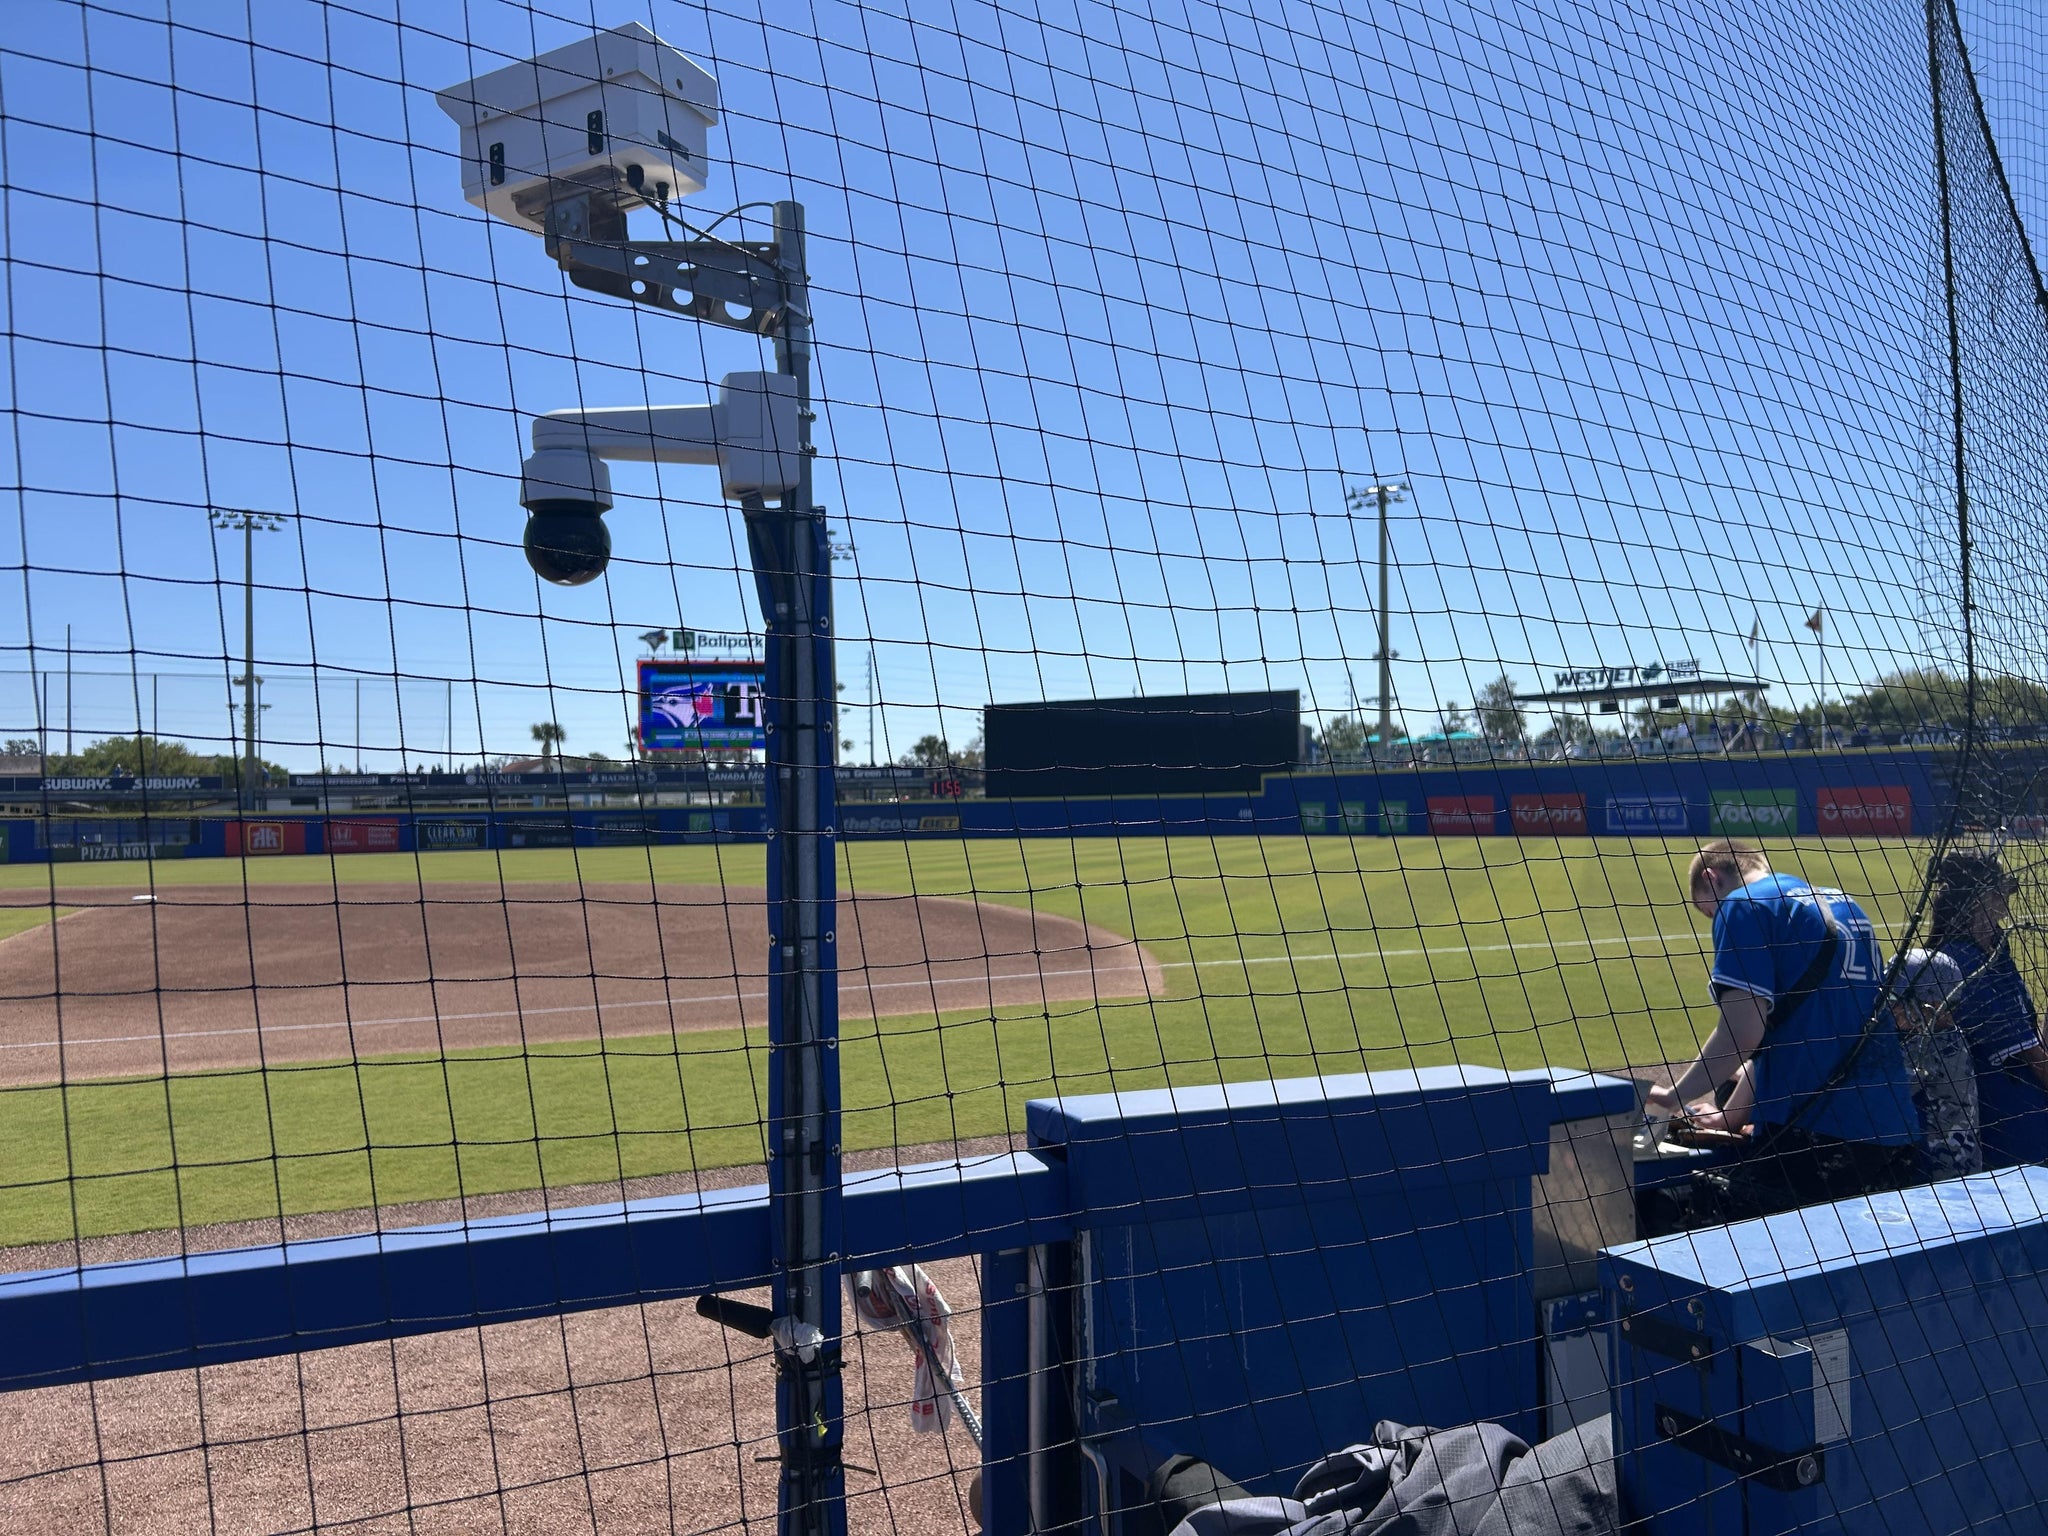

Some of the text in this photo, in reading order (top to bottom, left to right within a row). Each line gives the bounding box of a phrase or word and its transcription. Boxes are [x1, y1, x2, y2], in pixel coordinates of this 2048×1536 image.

[677, 633, 763, 649] TD Ballpark
[1554, 665, 1635, 687] WESTJET
[40, 778, 111, 790] SUBWAY
[133, 778, 200, 790] SUBWAY
[1302, 808, 1323, 827] TD
[1342, 807, 1363, 827] TD
[1382, 806, 1404, 827] TD
[1515, 804, 1582, 823] Kubota
[1617, 808, 1678, 820] THE KEG
[1842, 804, 1905, 820] ROGERS
[844, 817, 918, 830] theScore
[81, 846, 156, 860] PIZZA NOVA
[1833, 918, 1882, 981] 27
